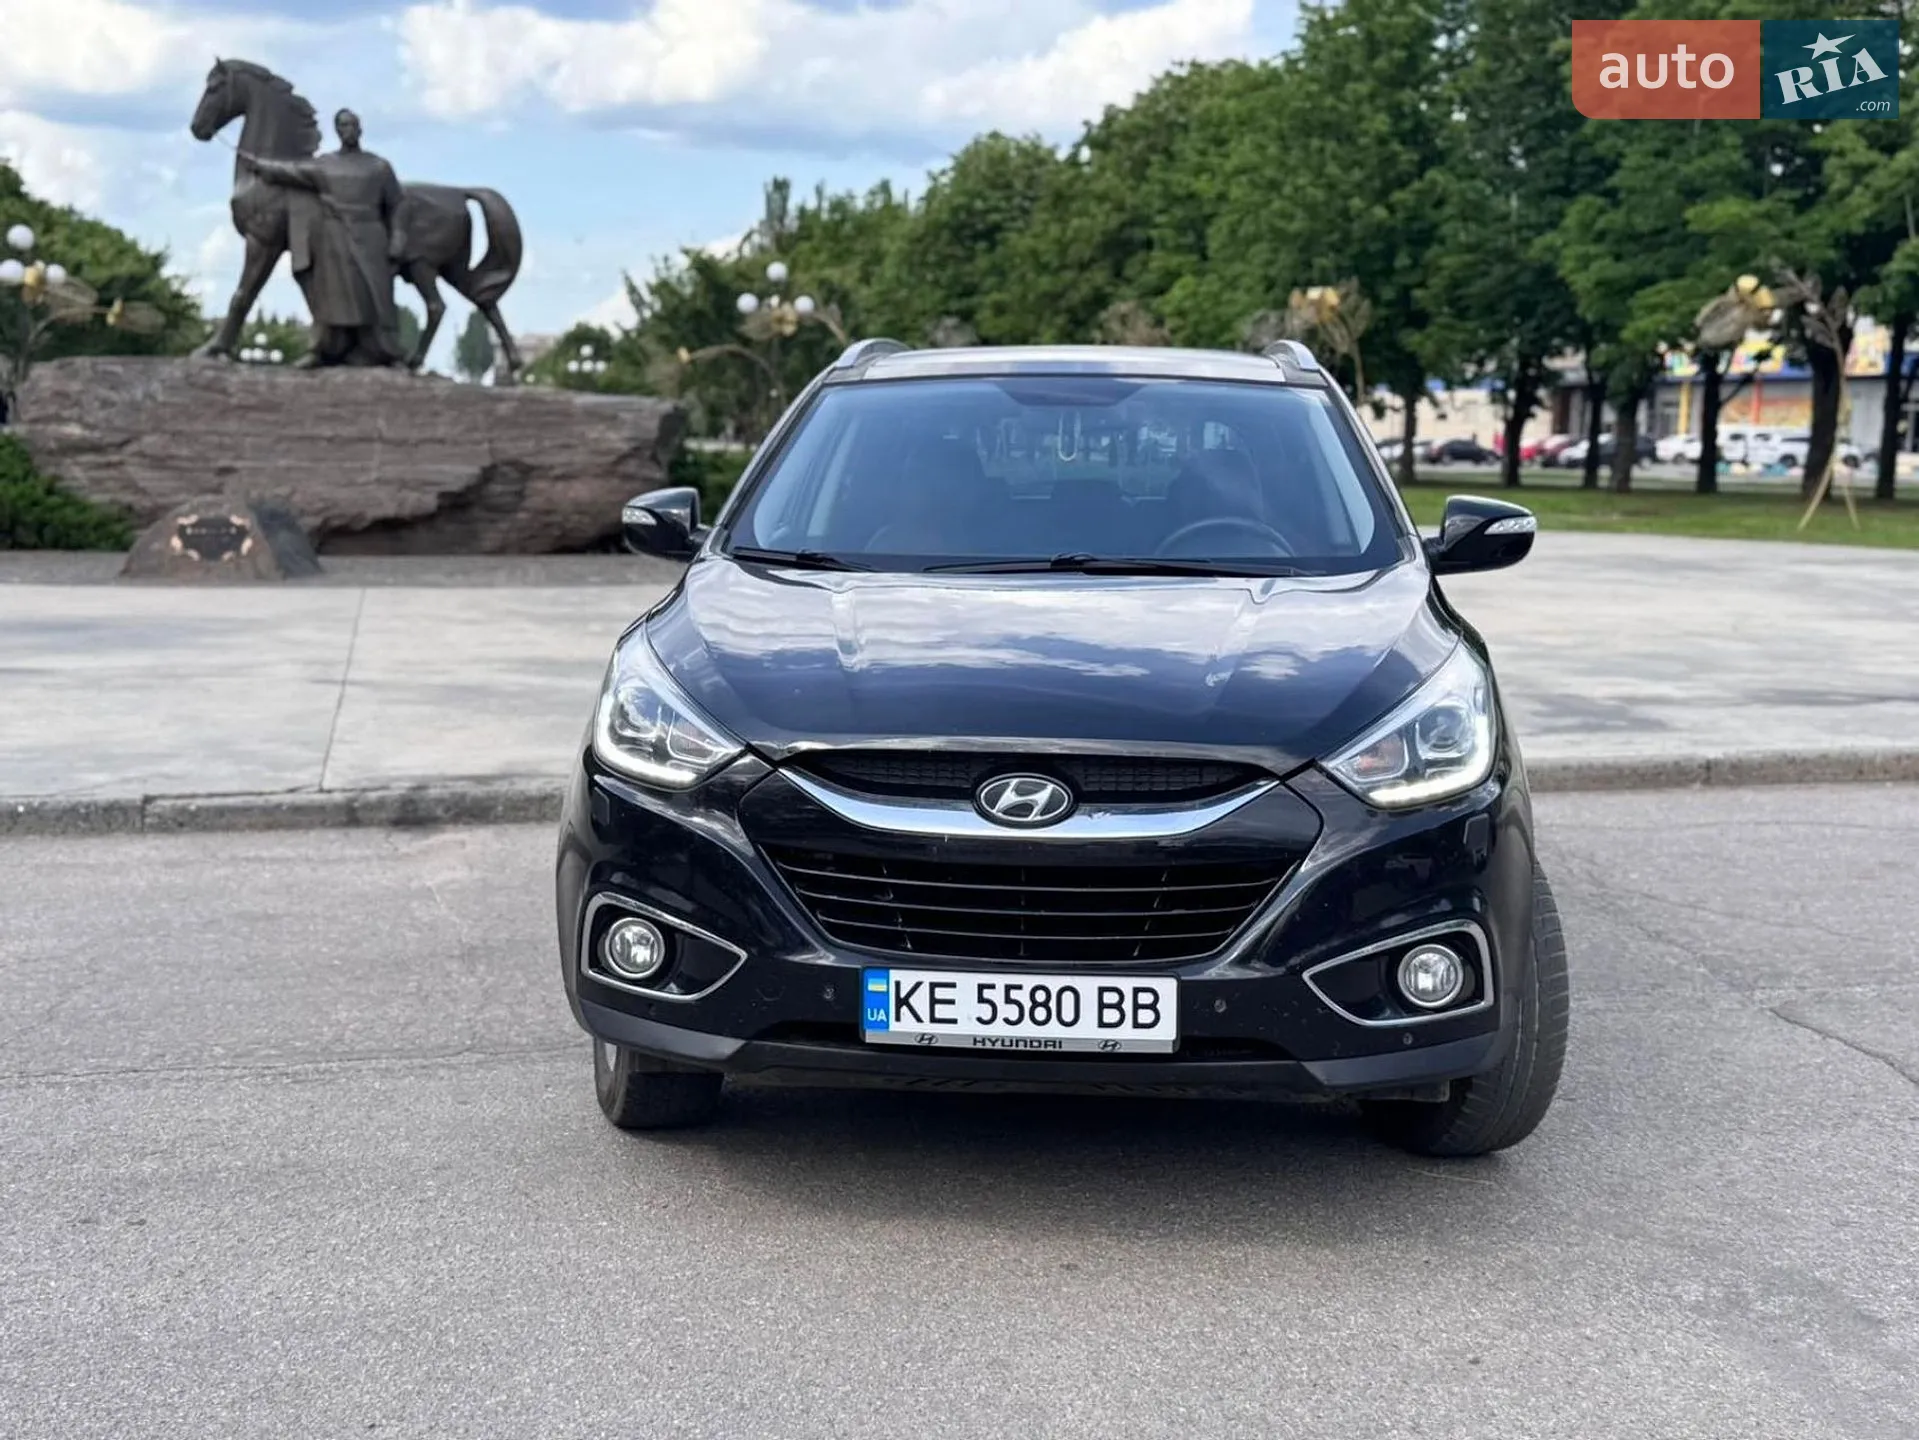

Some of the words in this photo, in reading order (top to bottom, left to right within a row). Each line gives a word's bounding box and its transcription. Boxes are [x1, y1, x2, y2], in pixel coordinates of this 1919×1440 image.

[894, 980, 958, 1025] KE
[975, 983, 1081, 1027] 5580
[1097, 986, 1161, 1029] BB
[867, 1008, 887, 1021] UA
[972, 1036, 1063, 1050] HYUNDAI
